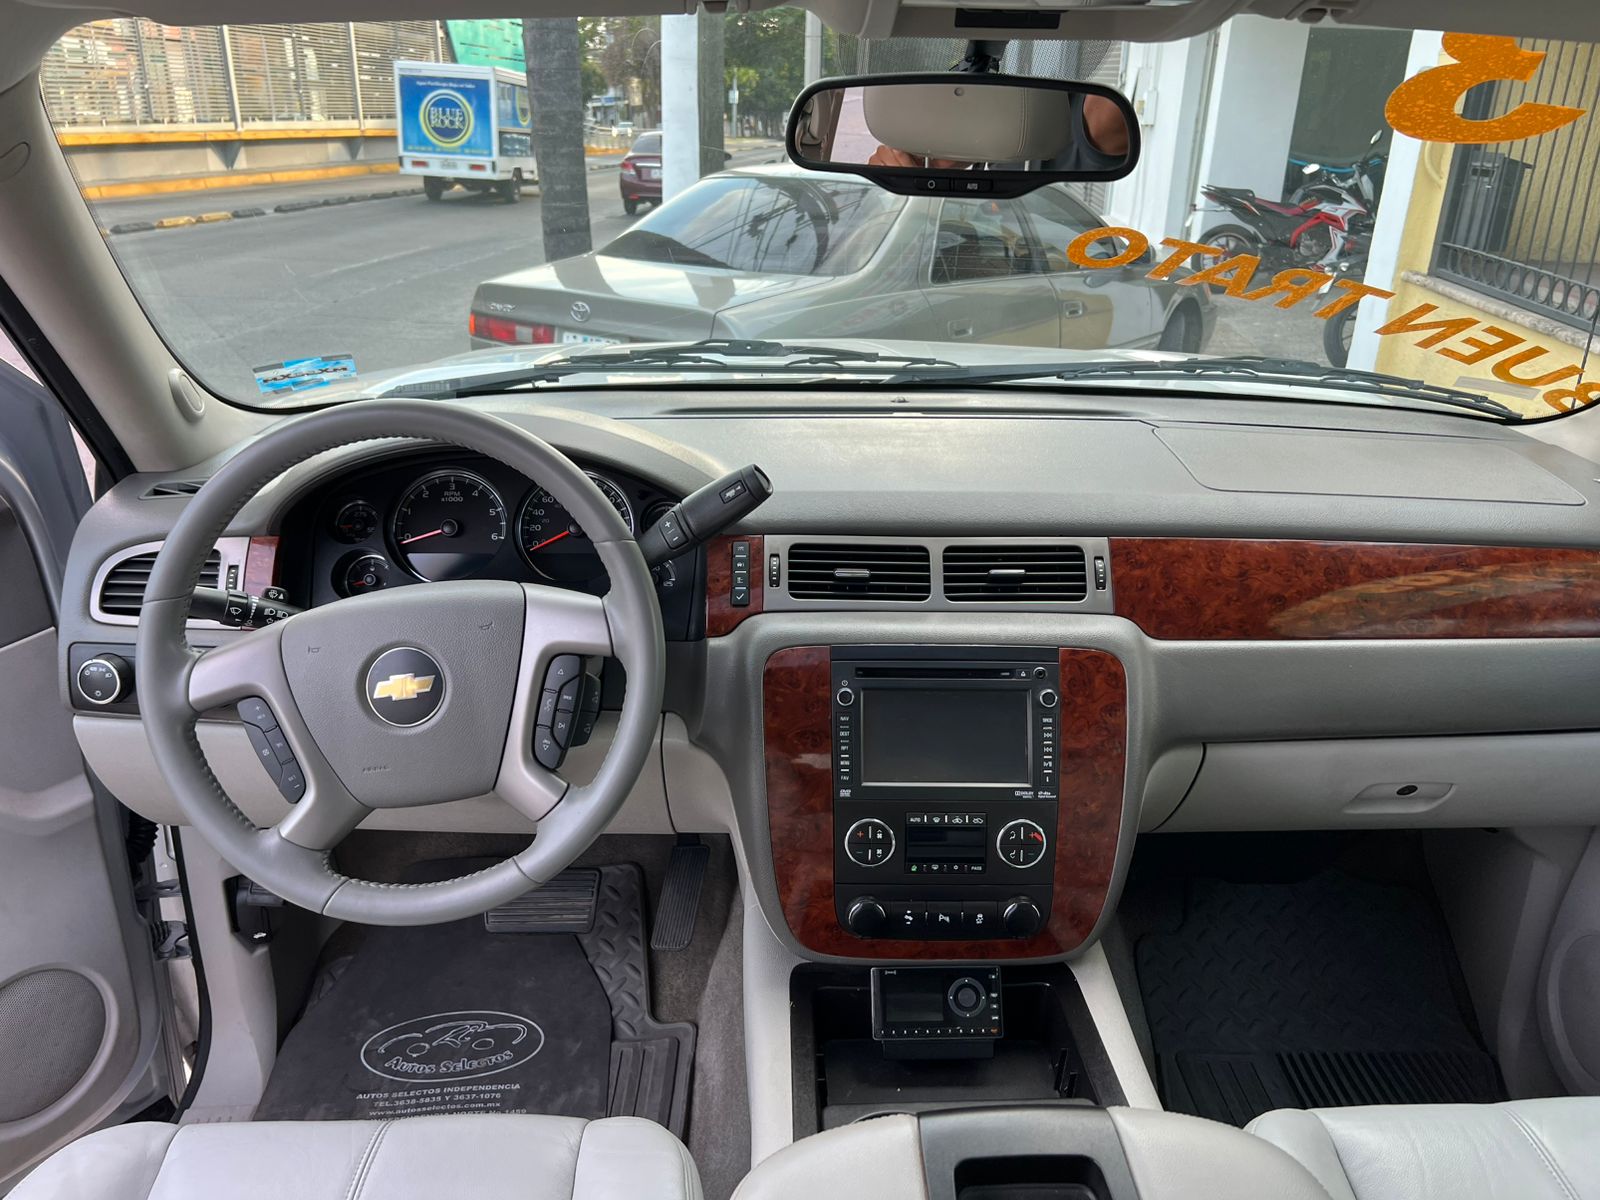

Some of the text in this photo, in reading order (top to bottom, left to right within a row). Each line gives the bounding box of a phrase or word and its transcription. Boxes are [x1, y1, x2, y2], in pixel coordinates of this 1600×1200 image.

[430, 107, 463, 118] BLUE
[489, 508, 496, 516] 5
[532, 508, 545, 516] 40
[355, 1083, 521, 1100] AUTOS SELECTOS INDEPENDENCIA
